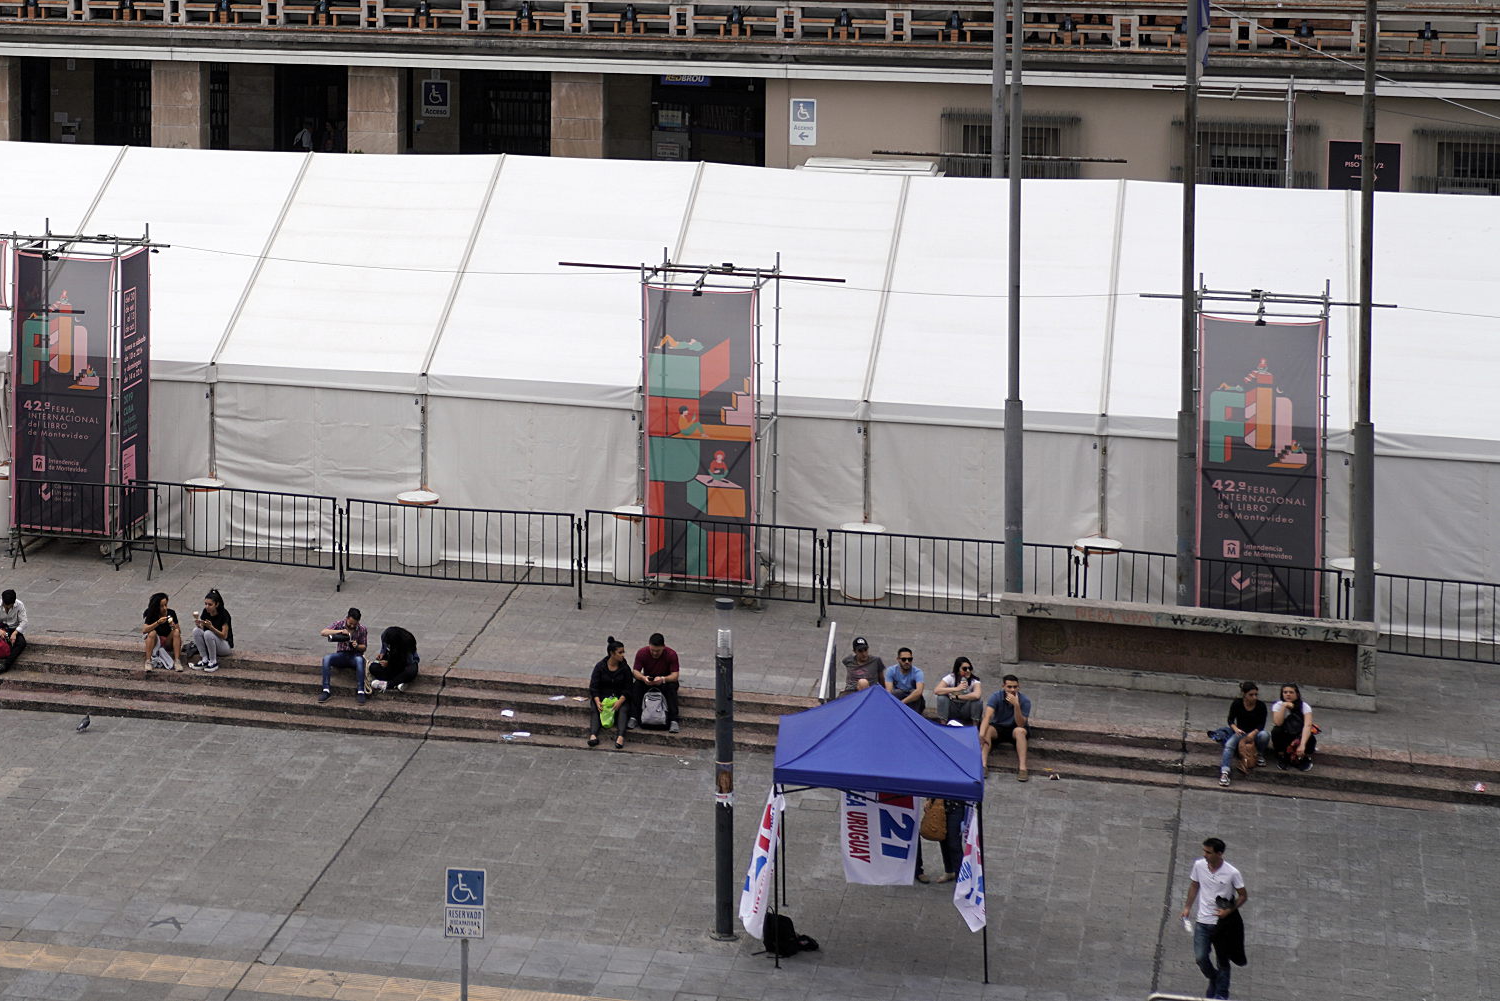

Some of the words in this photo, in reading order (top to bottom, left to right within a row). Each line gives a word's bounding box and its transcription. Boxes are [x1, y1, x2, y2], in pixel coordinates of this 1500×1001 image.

[28, 413, 100, 424] INTERNACIONAL
[41, 430, 89, 439] Montevideo
[56, 465, 87, 473] Montevideo
[1248, 486, 1277, 494] FERIA
[1218, 493, 1306, 506] INTERNACIONAL
[1217, 502, 1233, 510] del
[1238, 504, 1268, 512] LIBRO
[1235, 513, 1294, 523] Montevideo
[1244, 543, 1283, 552] Intendencia
[1253, 552, 1293, 560] Montevideo
[847, 811, 871, 863] URUGUAY
[449, 910, 481, 919] RESERVADO
